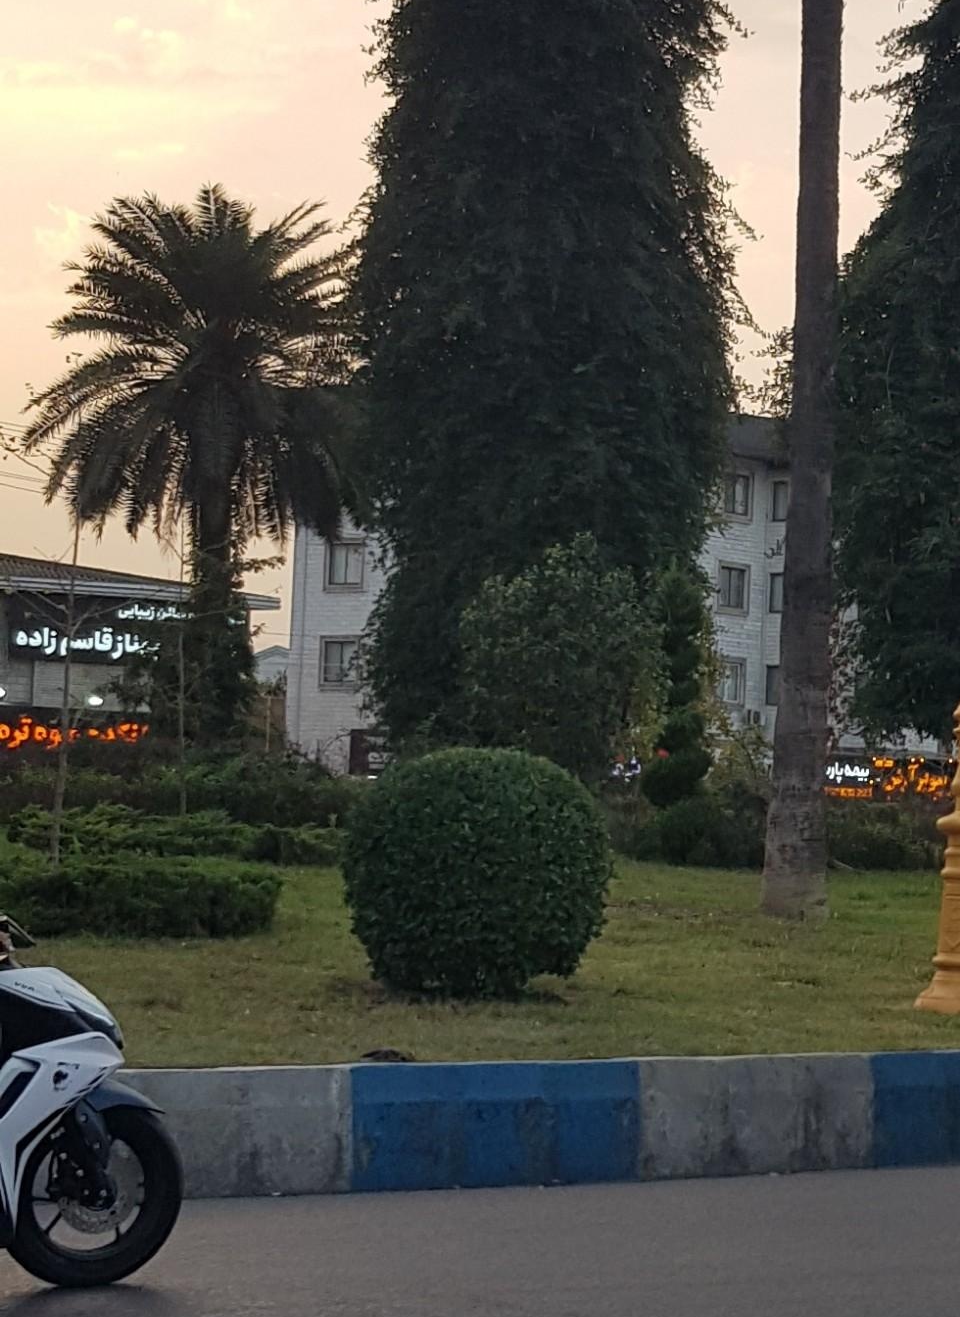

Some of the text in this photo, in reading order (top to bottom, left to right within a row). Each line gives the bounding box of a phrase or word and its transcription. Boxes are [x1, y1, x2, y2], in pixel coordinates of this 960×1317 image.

[118, 603, 155, 620] زیبایی
[15, 627, 57, 655] زاده
[60, 627, 113, 657] قاسم
[844, 763, 870, 782] بیمه
